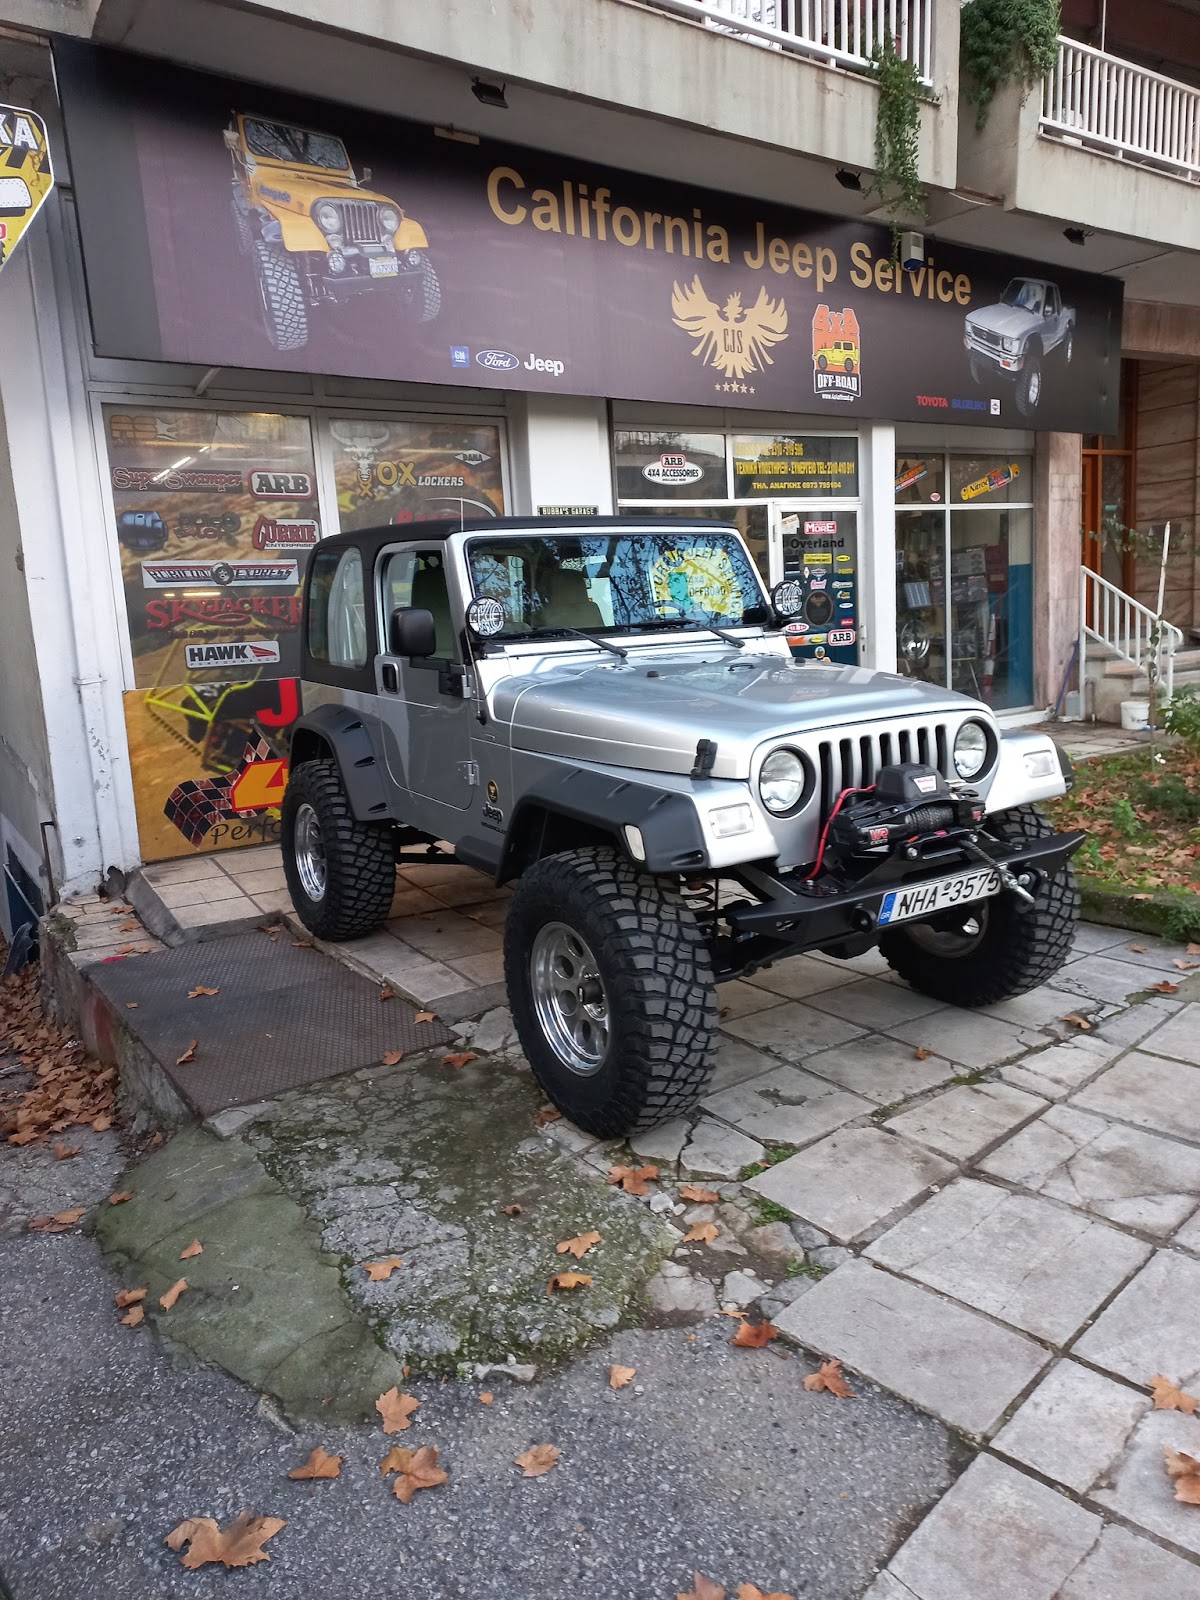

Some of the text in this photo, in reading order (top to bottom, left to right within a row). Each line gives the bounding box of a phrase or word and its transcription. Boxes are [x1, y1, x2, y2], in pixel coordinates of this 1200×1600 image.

[487, 166, 972, 305] California Jeep Service
[723, 328, 743, 353] CJS
[454, 350, 565, 376] GM Ford Jeep
[817, 373, 857, 392] OFF-ROAD
[916, 395, 948, 408] TOYOTA
[951, 399, 987, 411] SUZUKI
[462, 453, 483, 462] DANA
[664, 457, 683, 466] ARB
[165, 469, 242, 492] Swamper
[376, 460, 464, 487] OX LOCKERS
[647, 468, 699, 478] 4X4 ACCESSORIES
[256, 474, 310, 494] ARB
[542, 507, 595, 515] BUBBA'S GARAGE
[252, 515, 317, 551] CURRIE
[791, 538, 844, 549] Overland
[148, 569, 294, 582] RUBICON EXPRESS
[832, 632, 852, 642] ARB
[189, 644, 249, 662] HAWK
[482, 801, 504, 825] Jeep
[880, 911, 891, 920] GR
